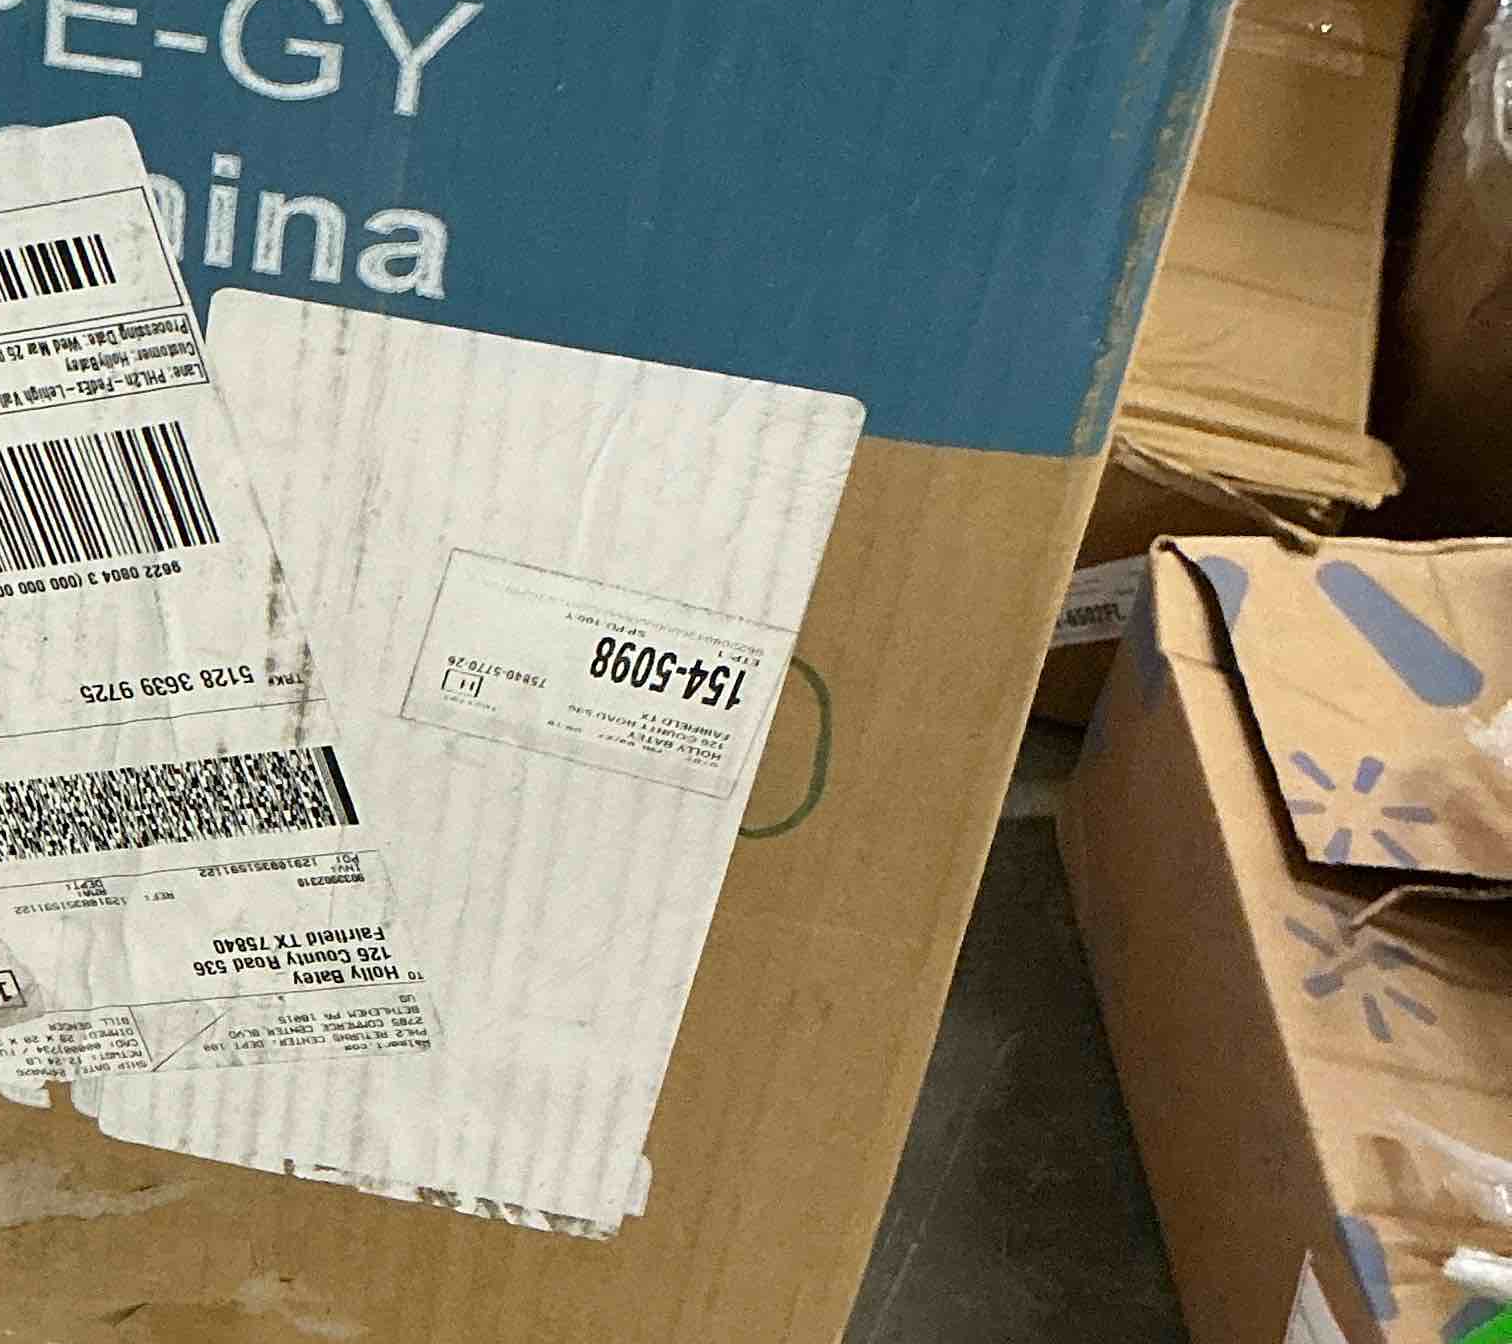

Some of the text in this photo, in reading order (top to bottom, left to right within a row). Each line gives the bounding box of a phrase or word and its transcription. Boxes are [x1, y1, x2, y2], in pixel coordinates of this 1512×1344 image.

[81, 329, 118, 349] Date:
[118, 318, 188, 342] Processing
[6, 345, 23, 361] 25
[26, 342, 49, 357] Mar
[52, 336, 80, 354] Wed
[132, 341, 196, 362] Customer:
[168, 363, 204, 379] Lane:
[102, 566, 138, 582] 0804
[143, 560, 182, 576] 9622
[17, 579, 46, 595] 000
[50, 572, 82, 592] (000
[140, 672, 194, 696] 3639
[199, 666, 254, 688] 5128
[589, 636, 747, 712] 154-5098
[79, 681, 134, 704] 9725
[661, 717, 731, 742] FAIRFIELD
[677, 740, 723, 762] HOLLY
[212, 926, 385, 954] Fairfield TX 75840
[193, 946, 392, 976] 126 County Road 536
[292, 964, 424, 986] TO Holly Batey
[323, 1005, 419, 1021] BETHLEHEM PA
[228, 1019, 384, 1040] COMMERCE CENTER BLVD
[332, 1029, 388, 1042] RETURNS
[233, 1039, 265, 1050] DEPT
